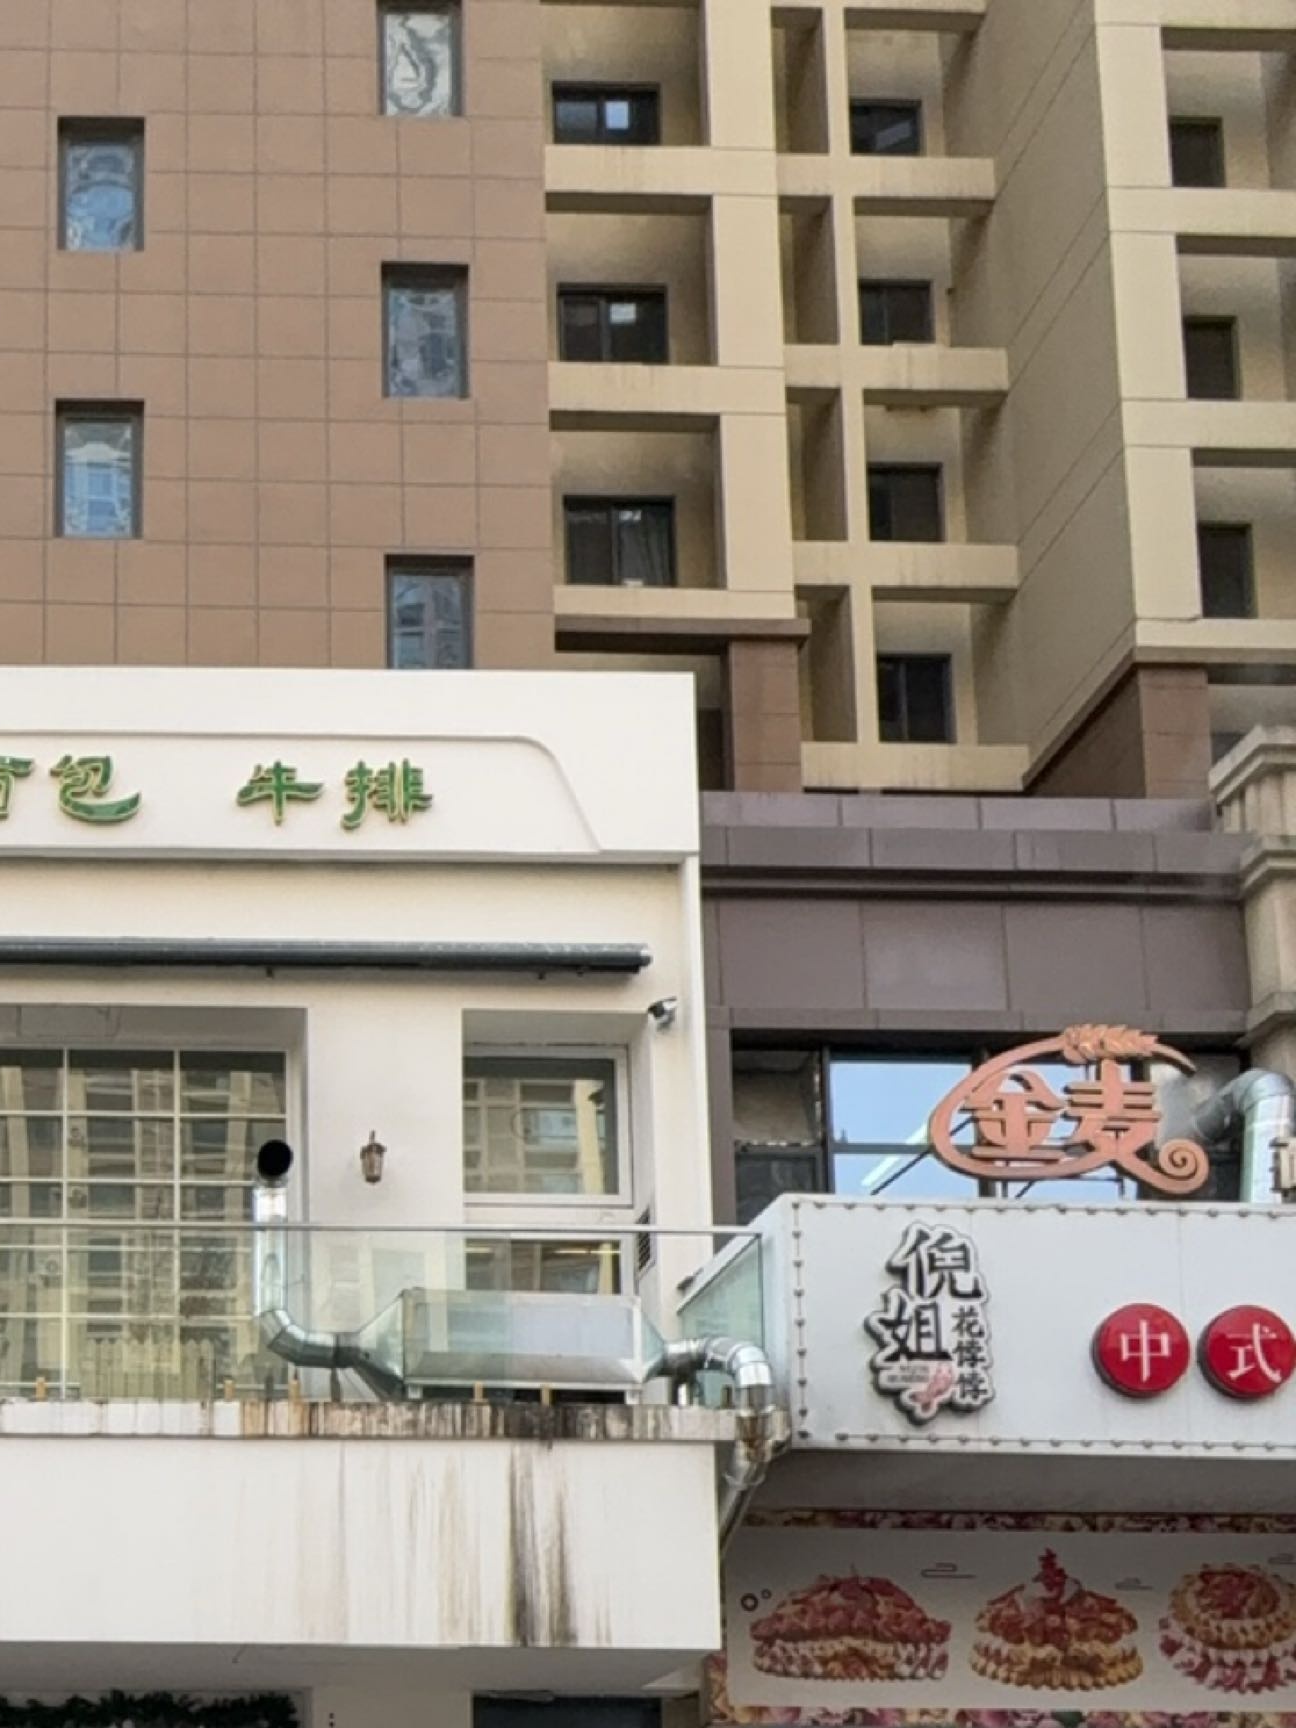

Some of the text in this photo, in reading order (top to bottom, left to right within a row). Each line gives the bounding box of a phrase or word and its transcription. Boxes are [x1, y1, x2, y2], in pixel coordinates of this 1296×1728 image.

[236, 757, 434, 831] 牛排
[939, 1050, 1204, 1190] 金麦
[878, 1227, 984, 1363] 倪姐
[1119, 1319, 1282, 1384] 中式
